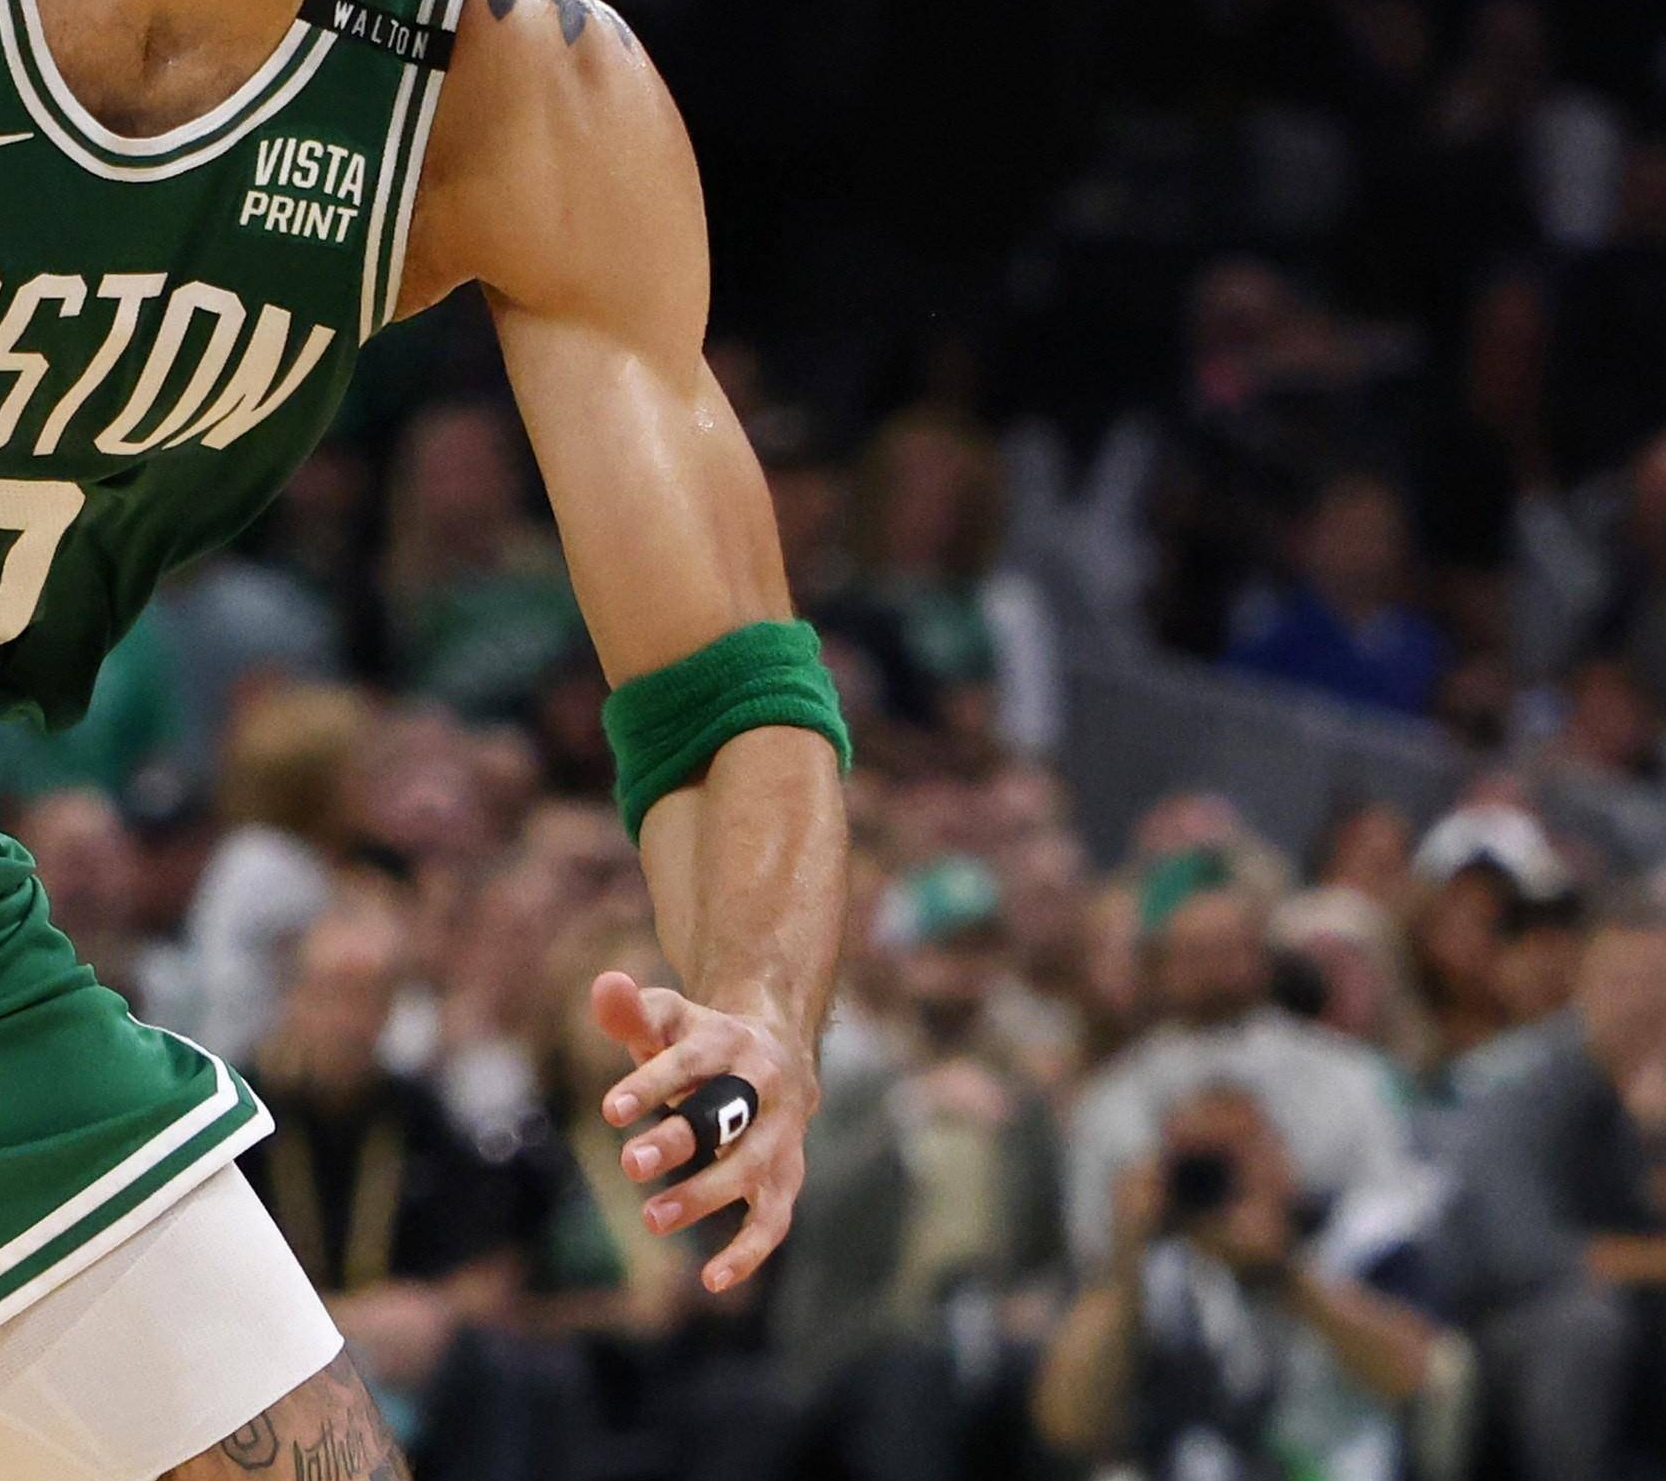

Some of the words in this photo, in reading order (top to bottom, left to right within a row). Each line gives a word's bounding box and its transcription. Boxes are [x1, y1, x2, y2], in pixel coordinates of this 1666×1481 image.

[332, 0, 430, 60] WALTON
[254, 137, 366, 207] VISTA
[239, 190, 359, 243] PRINT
